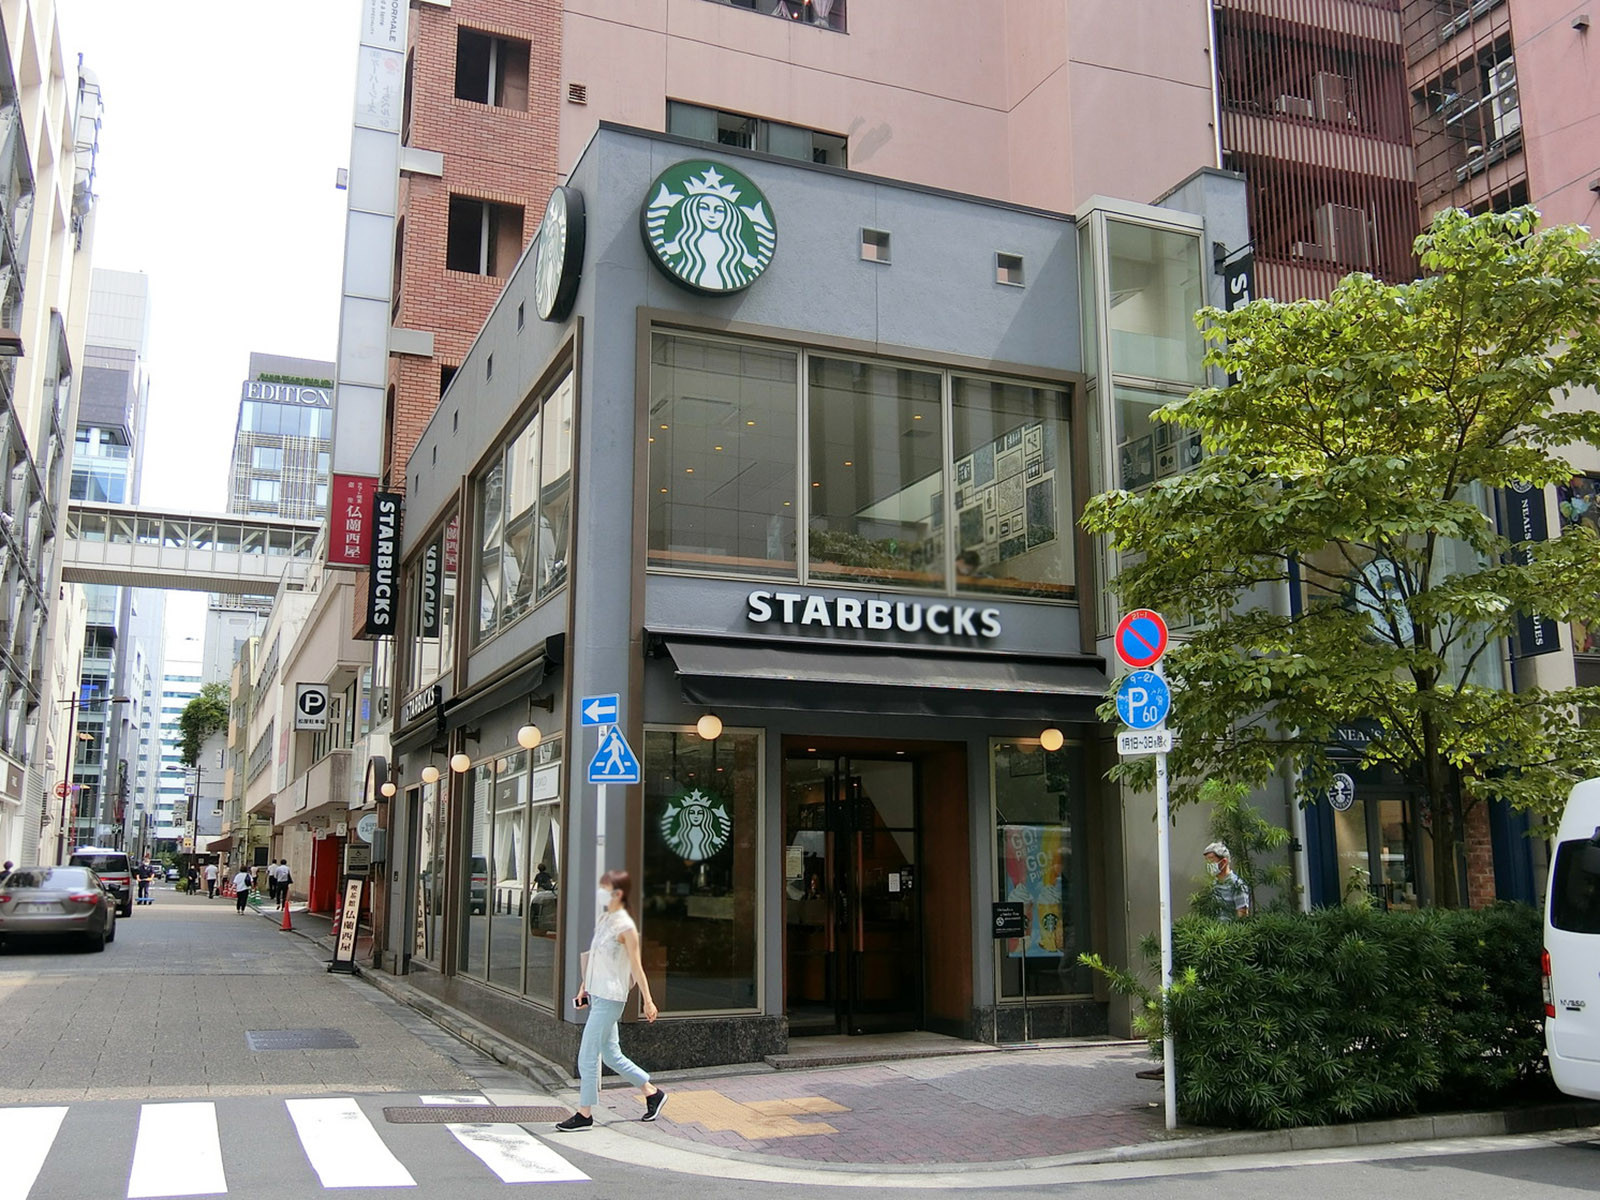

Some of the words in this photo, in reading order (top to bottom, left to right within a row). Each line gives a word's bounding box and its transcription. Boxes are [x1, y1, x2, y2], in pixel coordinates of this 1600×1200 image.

[389, 0, 399, 42] ORMALE
[246, 383, 331, 406] EDITION
[1521, 499, 1533, 541] NEAL'S
[373, 501, 396, 625] STARBUCKS
[748, 591, 1002, 638] STARBUCKS
[1129, 673, 1154, 684] 9-21
[1128, 687, 1148, 723] P
[1142, 706, 1158, 722] 60
